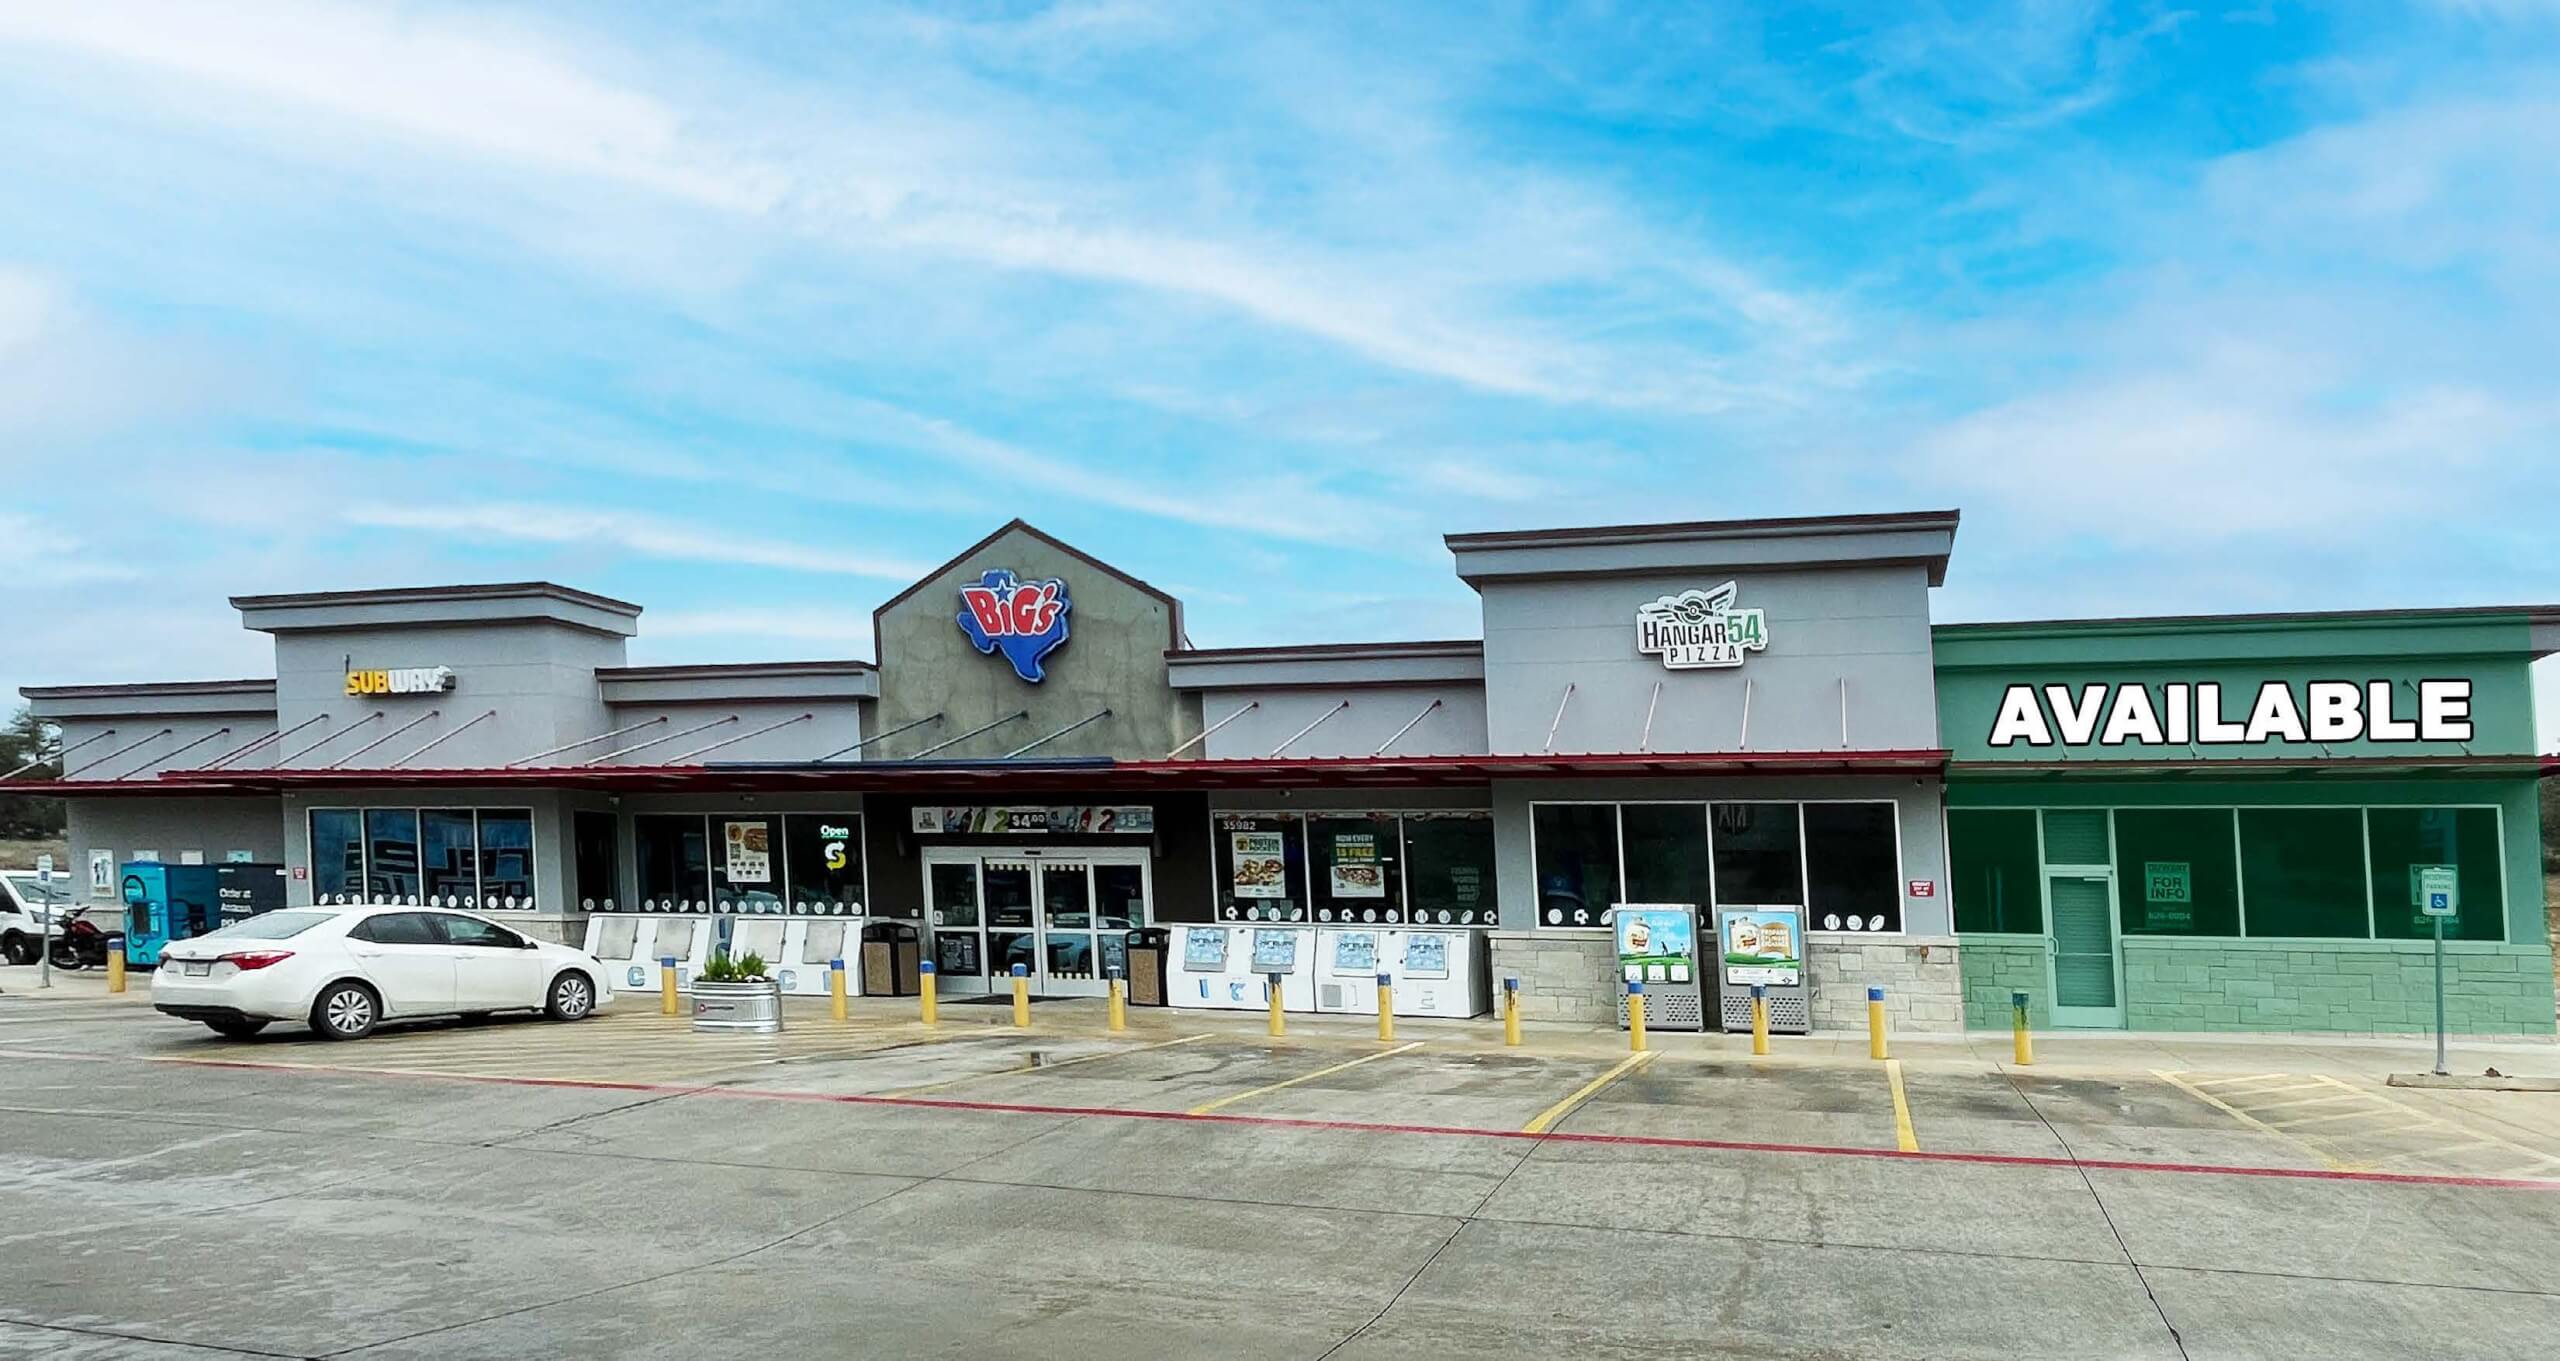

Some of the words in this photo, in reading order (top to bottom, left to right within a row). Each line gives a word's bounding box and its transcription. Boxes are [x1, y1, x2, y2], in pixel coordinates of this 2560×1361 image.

[1670, 645, 1737, 662] PIZZA
[345, 666, 443, 695] SUBWAY
[820, 824, 849, 837] Open
[2153, 877, 2182, 887] FOR
[2151, 887, 2185, 898] INFO
